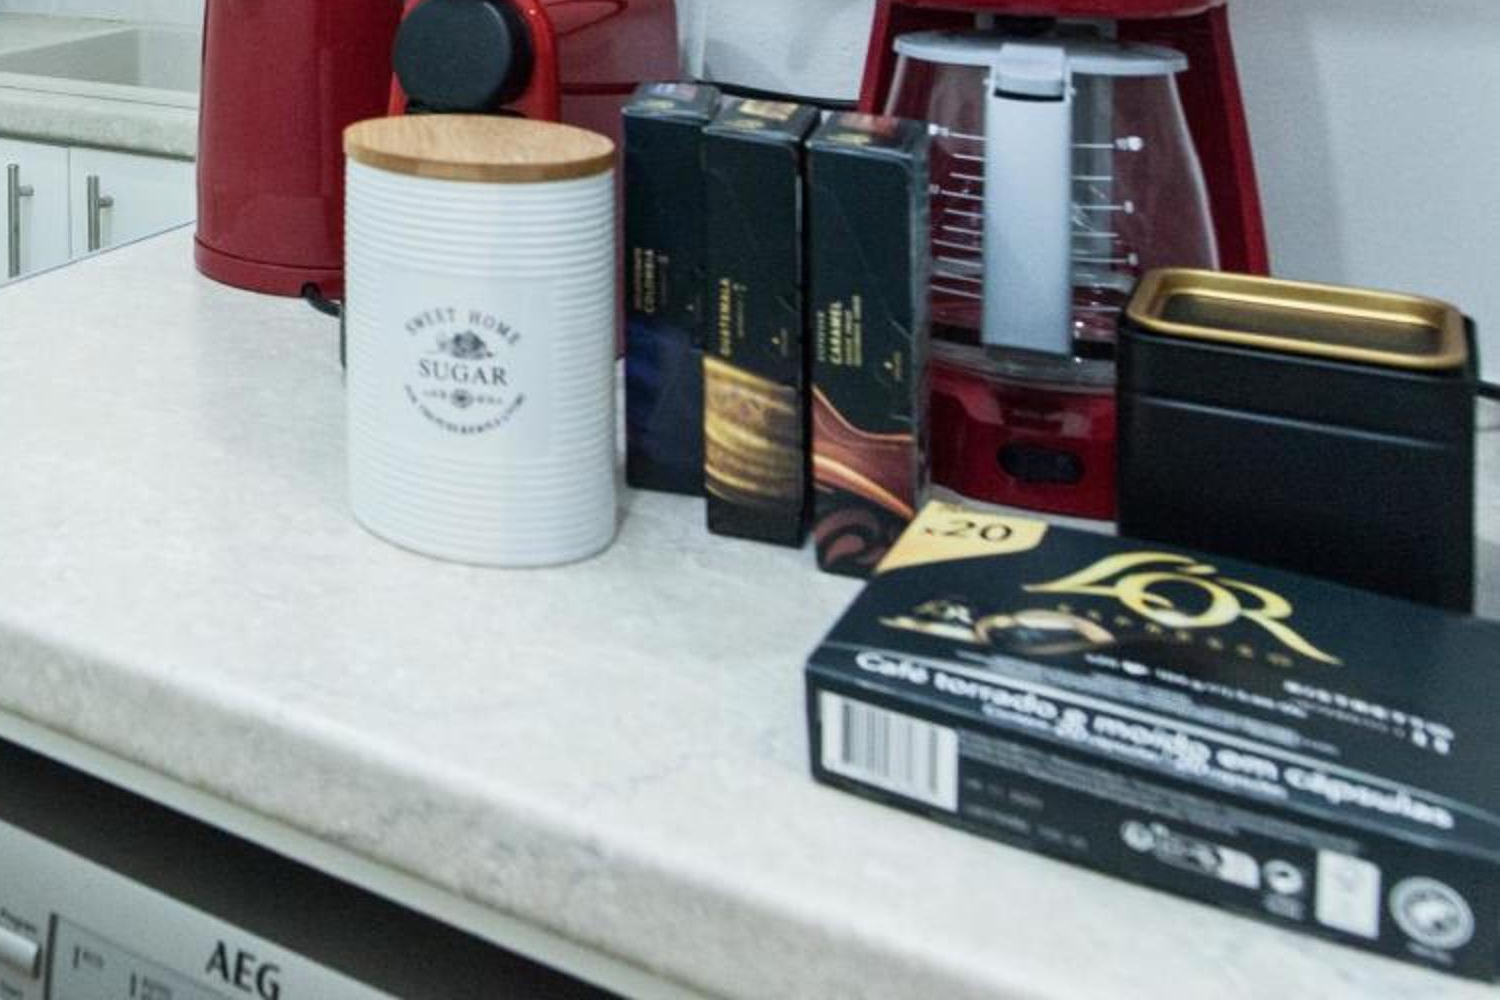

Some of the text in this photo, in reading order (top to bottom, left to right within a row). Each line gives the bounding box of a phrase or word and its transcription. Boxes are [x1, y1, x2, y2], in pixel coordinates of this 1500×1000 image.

[404, 307, 521, 346] SWEET HOME
[829, 302, 843, 366] CARAMEL
[419, 358, 509, 387] SUGAR
[1022, 550, 1343, 666] L'OR
[855, 650, 930, 685] Café
[933, 671, 1058, 720] torrado
[1215, 748, 1279, 782] em
[1283, 766, 1455, 830] cápsulas
[205, 939, 282, 1000] AEG
